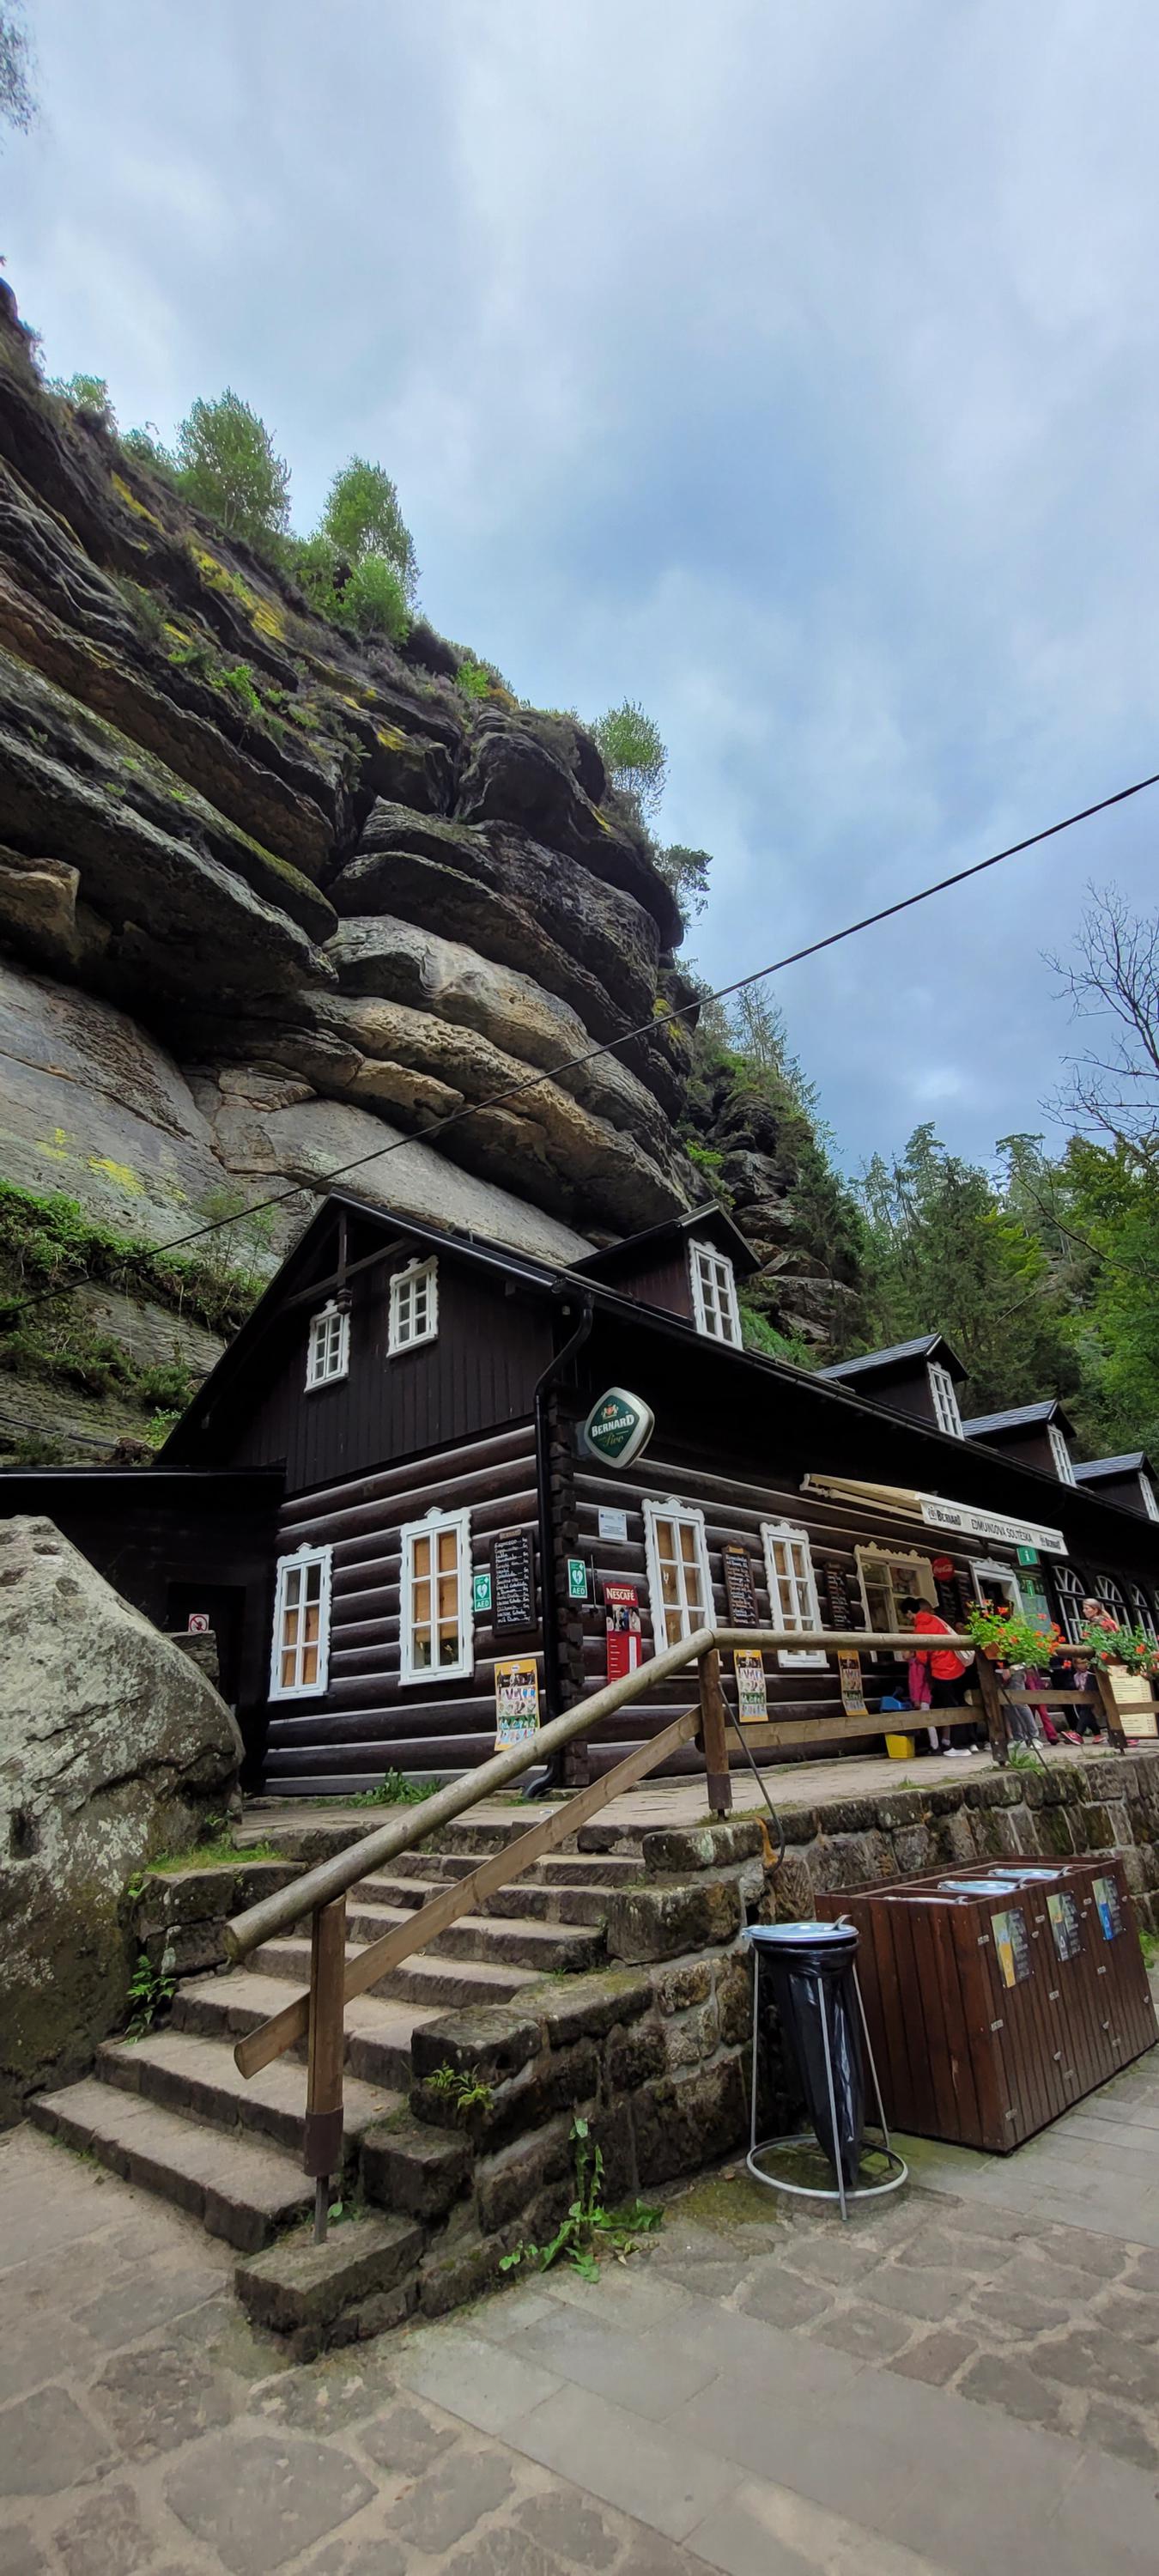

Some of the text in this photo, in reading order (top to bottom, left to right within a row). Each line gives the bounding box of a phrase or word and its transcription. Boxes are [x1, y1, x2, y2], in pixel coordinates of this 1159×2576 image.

[592, 1414, 634, 1437] BERNARD
[605, 1588, 635, 1601] NESCAFÉ
[476, 1600, 489, 1608] AED
